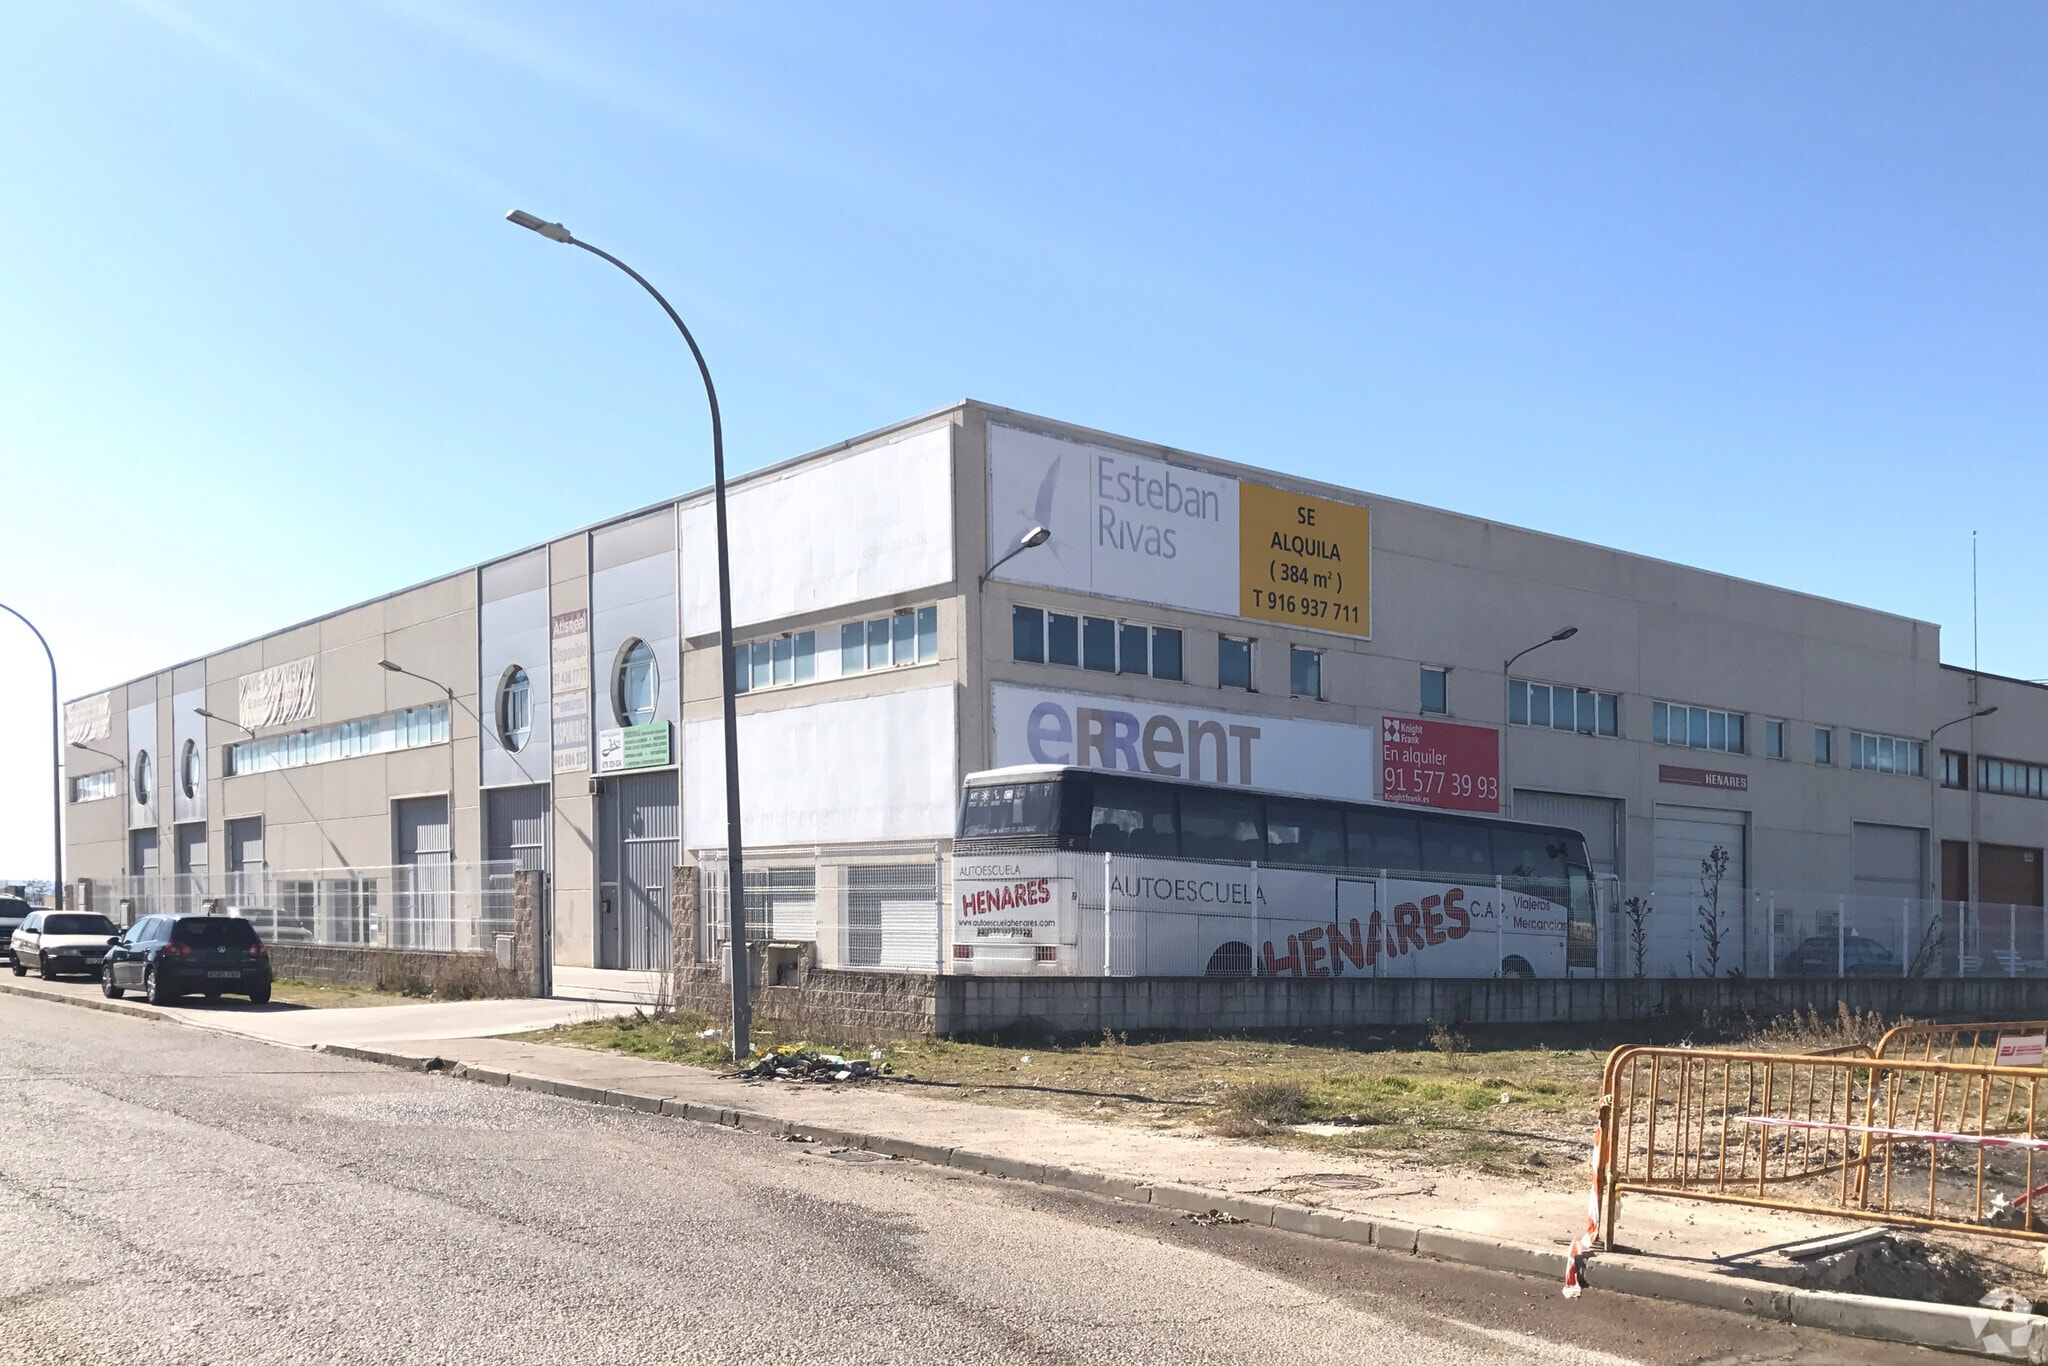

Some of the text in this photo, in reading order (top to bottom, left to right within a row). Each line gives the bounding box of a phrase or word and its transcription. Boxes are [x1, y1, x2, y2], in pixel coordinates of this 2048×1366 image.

[1098, 456, 1219, 522] Esteban
[1297, 506, 1316, 527] SE
[1098, 504, 1177, 559] Rivas
[1270, 531, 1342, 562] ALQUILA
[1280, 563, 1308, 585] 384
[1252, 589, 1358, 623] T 916 937 711
[1401, 723, 1423, 736] Knight
[1401, 735, 1420, 744] Frank
[1384, 745, 1447, 767] En alquiler
[1384, 767, 1498, 800] 91 577 39 93
[1705, 773, 1747, 788] HENARES
[960, 864, 1021, 877] AUTOESCUELA
[962, 879, 1051, 917] HENARES
[1513, 896, 1551, 912] Viajeros
[958, 919, 1056, 928] www.autoescuelahenares.com
[1111, 874, 1267, 905] AUTOESCUELA
[1263, 888, 1470, 977] HENARES
